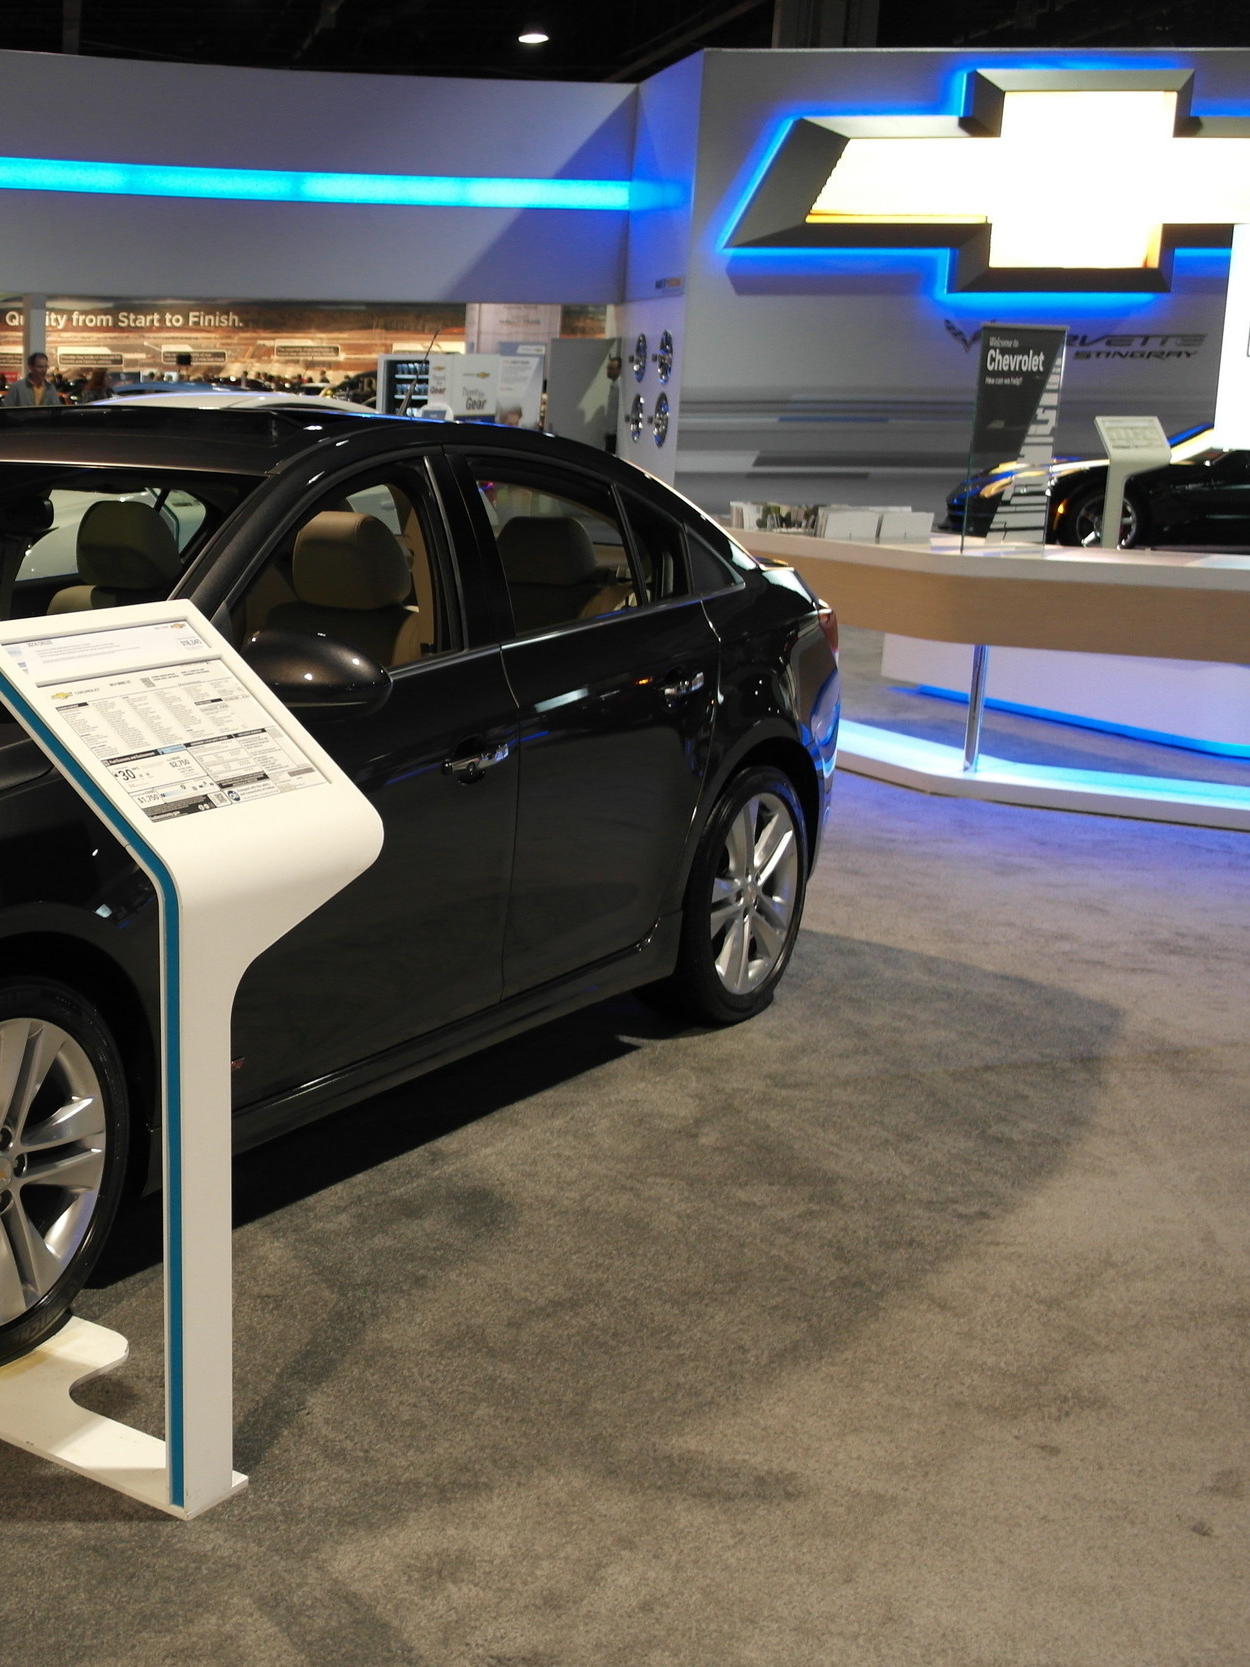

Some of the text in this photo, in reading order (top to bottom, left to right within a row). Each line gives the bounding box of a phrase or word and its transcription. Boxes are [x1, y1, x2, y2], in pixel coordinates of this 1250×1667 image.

[5, 311, 244, 329] Qity from Start to Finish.
[990, 336, 1019, 348] Welcome to
[986, 348, 1045, 372] Chevrolet
[1073, 351, 1198, 361] STINGRAY
[465, 397, 487, 410] Gear
[118, 769, 136, 782] 30
[137, 793, 160, 805] $1,750
